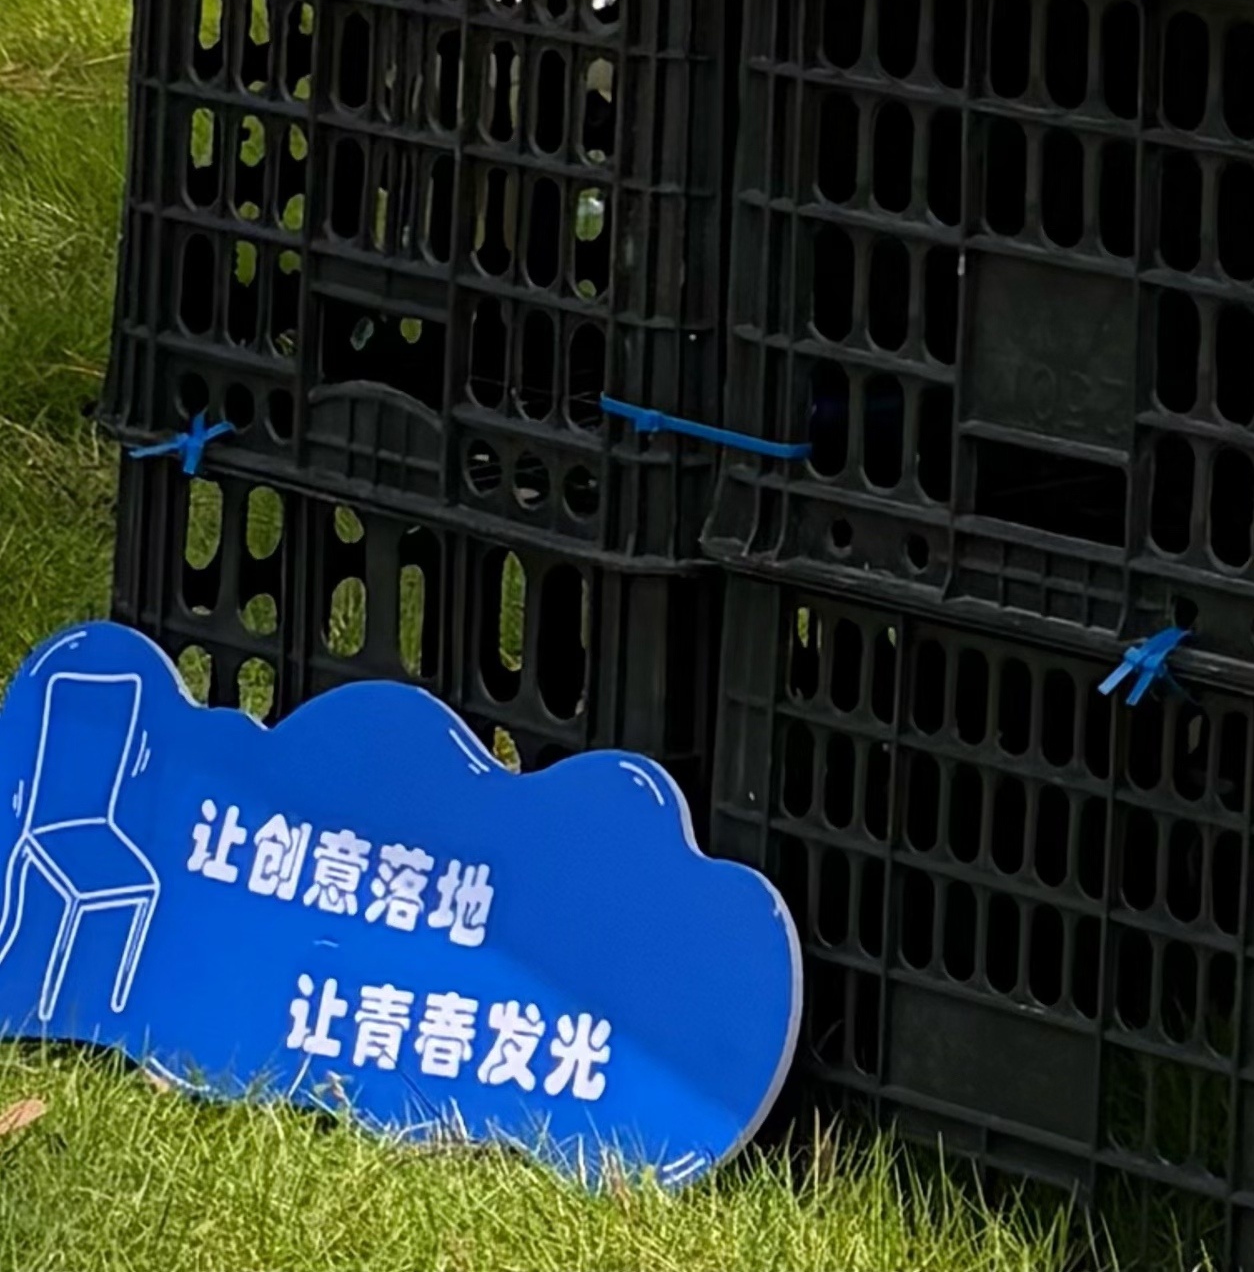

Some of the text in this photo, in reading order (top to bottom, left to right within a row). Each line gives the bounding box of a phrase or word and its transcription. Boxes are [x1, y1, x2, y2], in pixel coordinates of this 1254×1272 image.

[187, 799, 494, 947] 让创意落地
[286, 974, 612, 1101] 让青春发光
